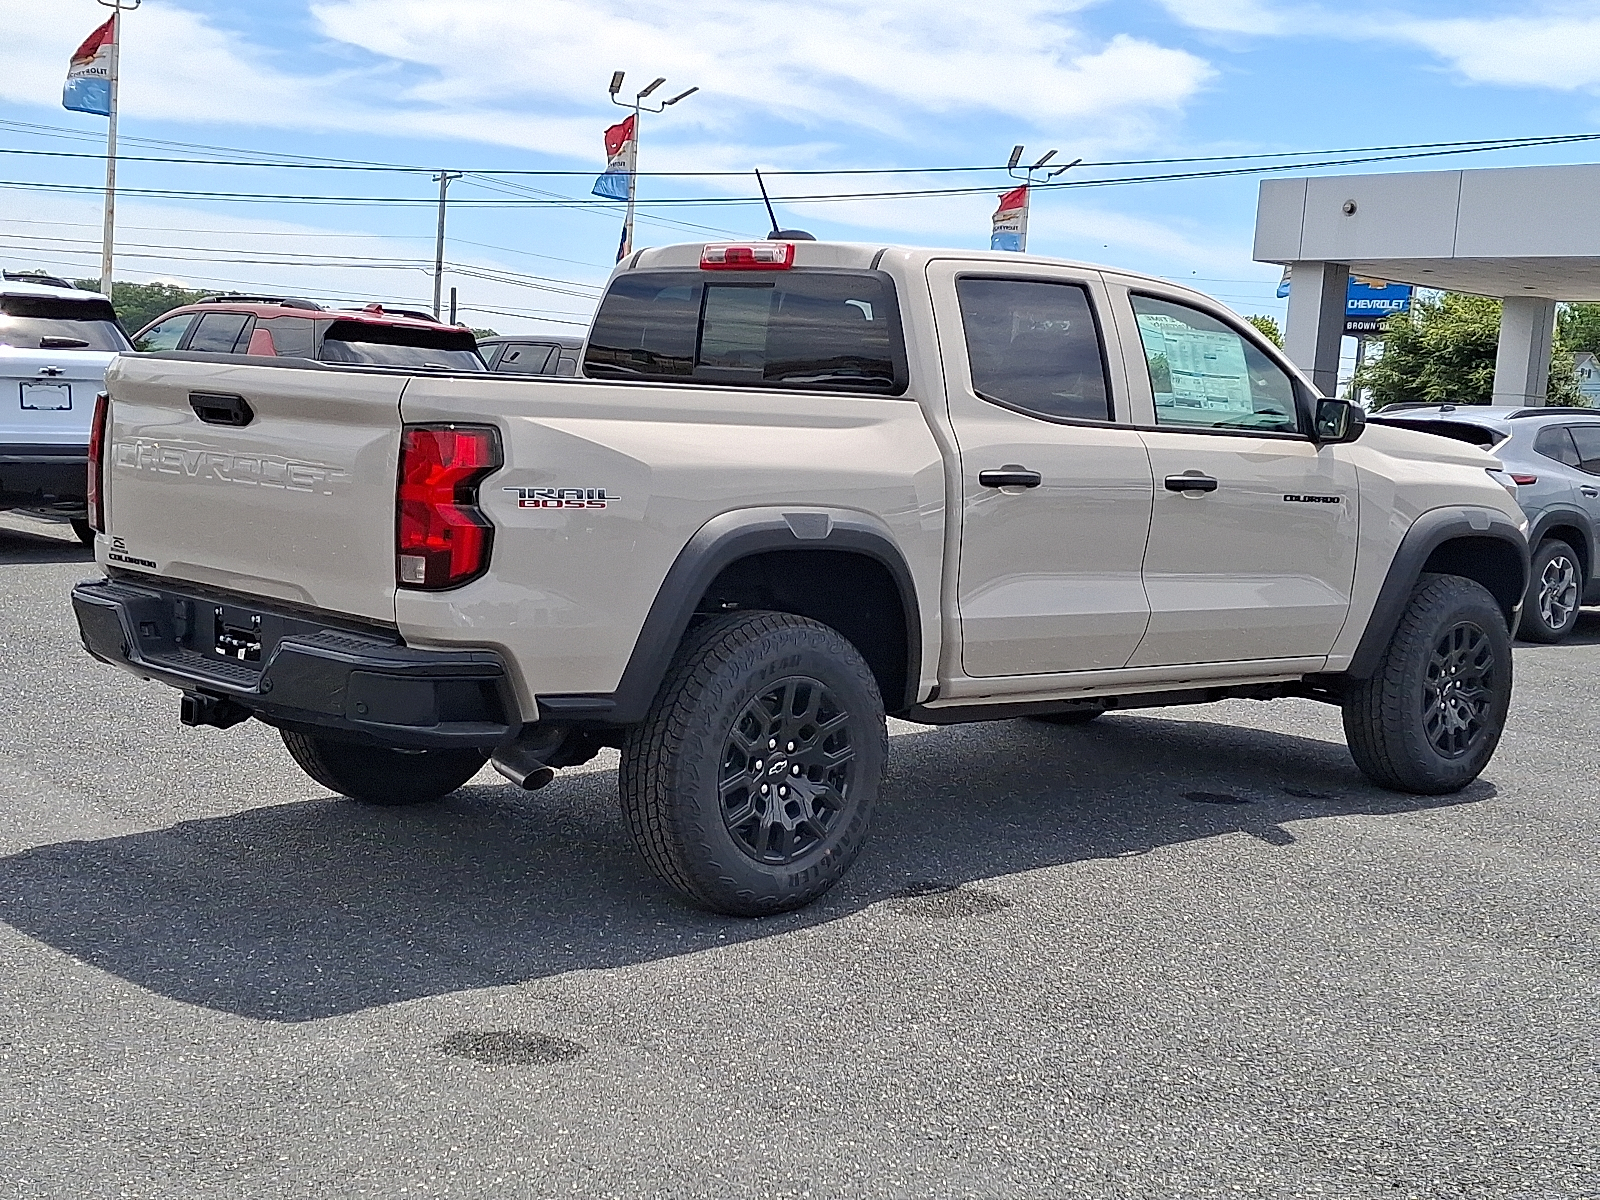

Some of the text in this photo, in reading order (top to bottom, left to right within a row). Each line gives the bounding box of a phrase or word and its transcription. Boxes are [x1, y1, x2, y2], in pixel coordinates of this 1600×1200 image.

[1347, 300, 1405, 309] CHEVROLET
[112, 440, 344, 495] CHEVROLET
[502, 487, 621, 500] TRAIL
[1283, 494, 1340, 503] COLORADO
[518, 500, 606, 509] BOSS
[109, 553, 156, 568] COLORADO
